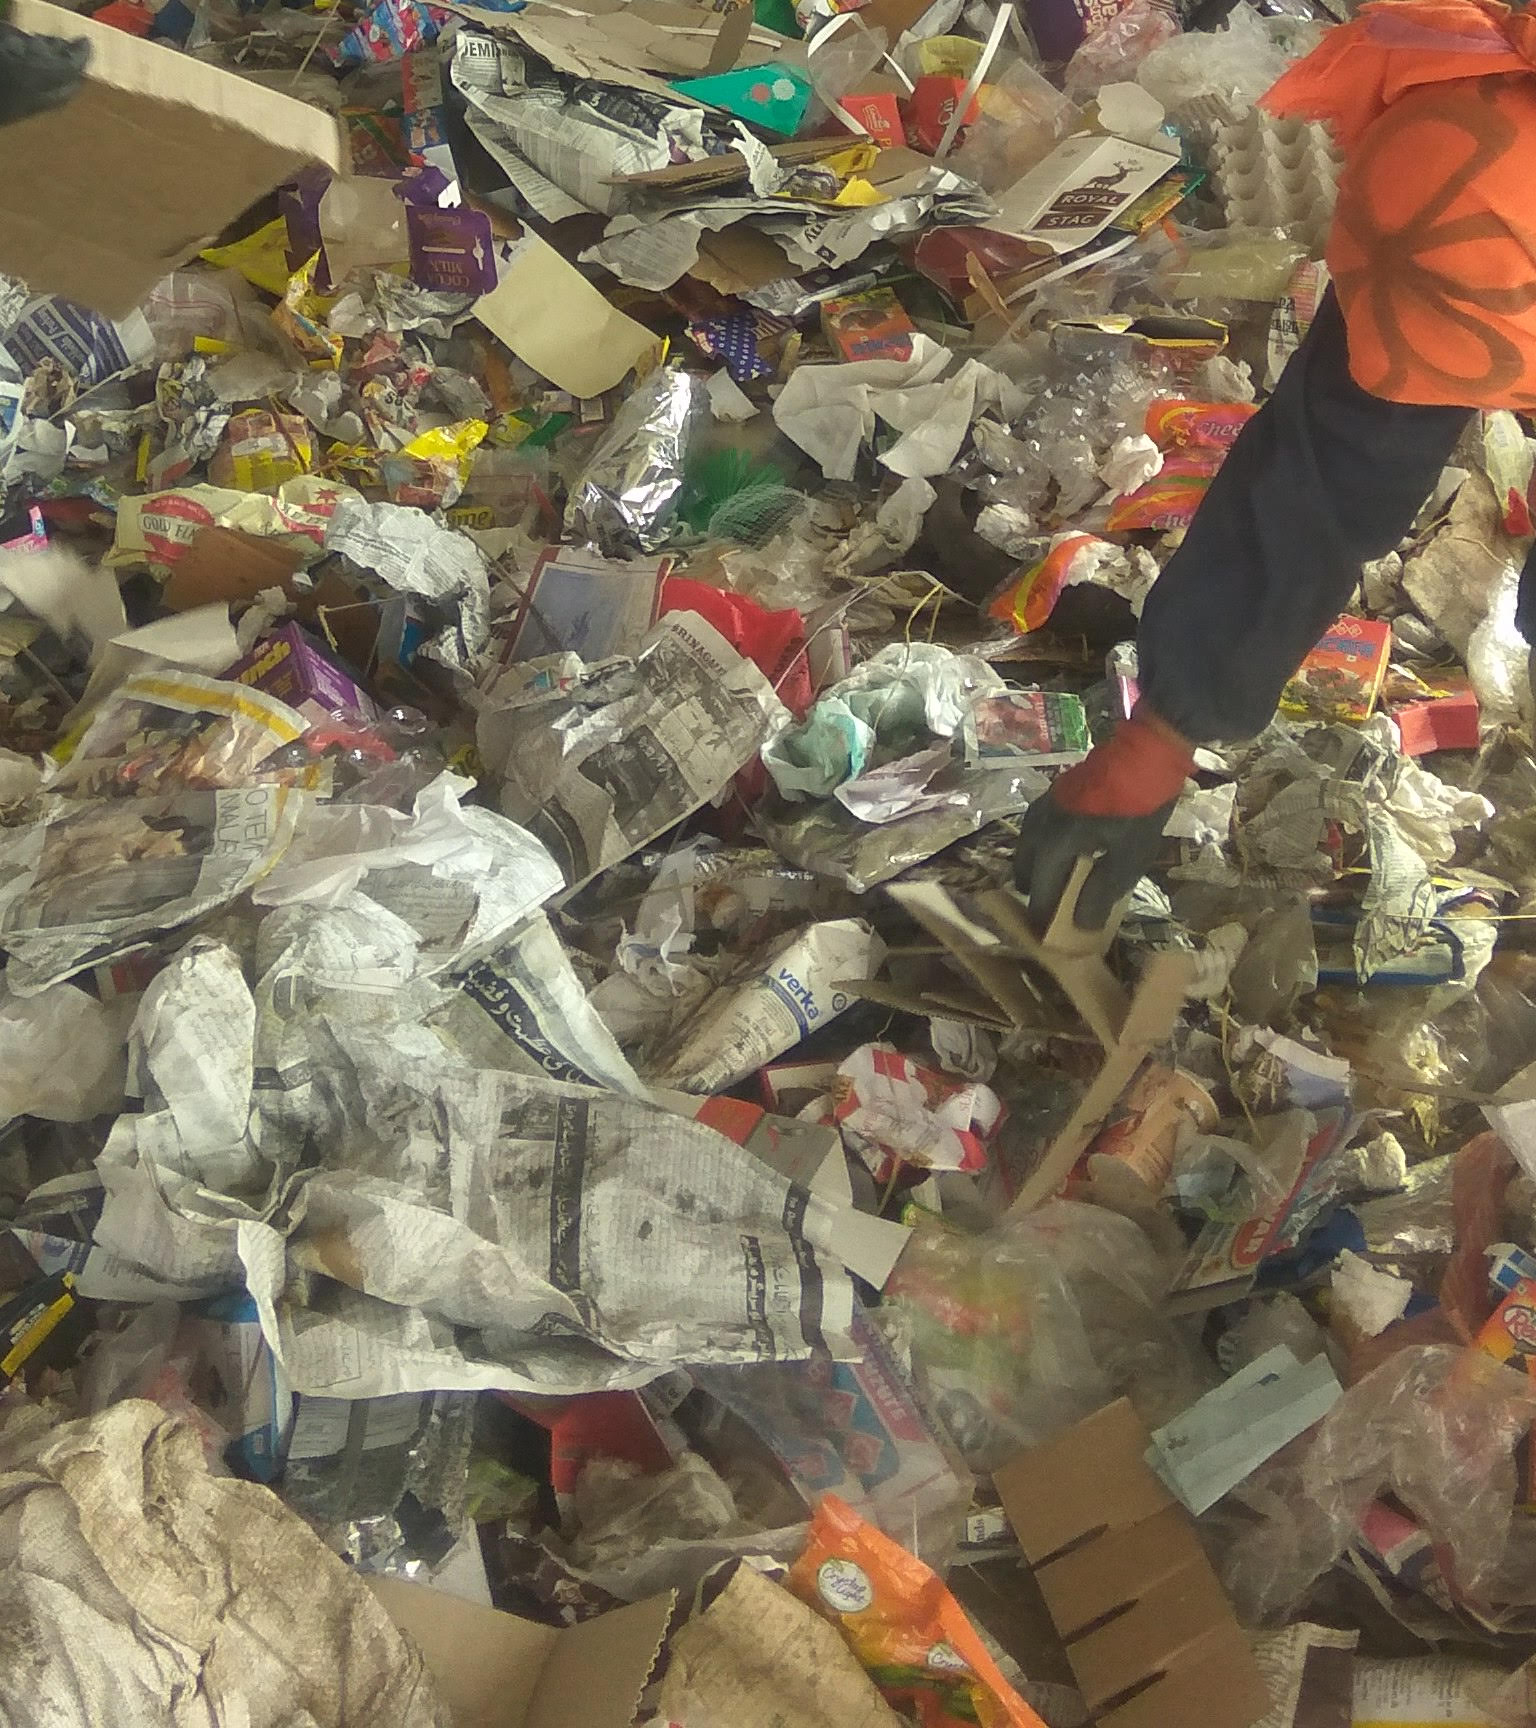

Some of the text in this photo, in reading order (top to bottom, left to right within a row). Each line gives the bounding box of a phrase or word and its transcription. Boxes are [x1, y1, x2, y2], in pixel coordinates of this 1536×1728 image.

[1062, 193, 1120, 206] ROYAL
[1048, 215, 1094, 227] STAG
[144, 515, 171, 531] GOLD
[779, 967, 820, 1020] verka
